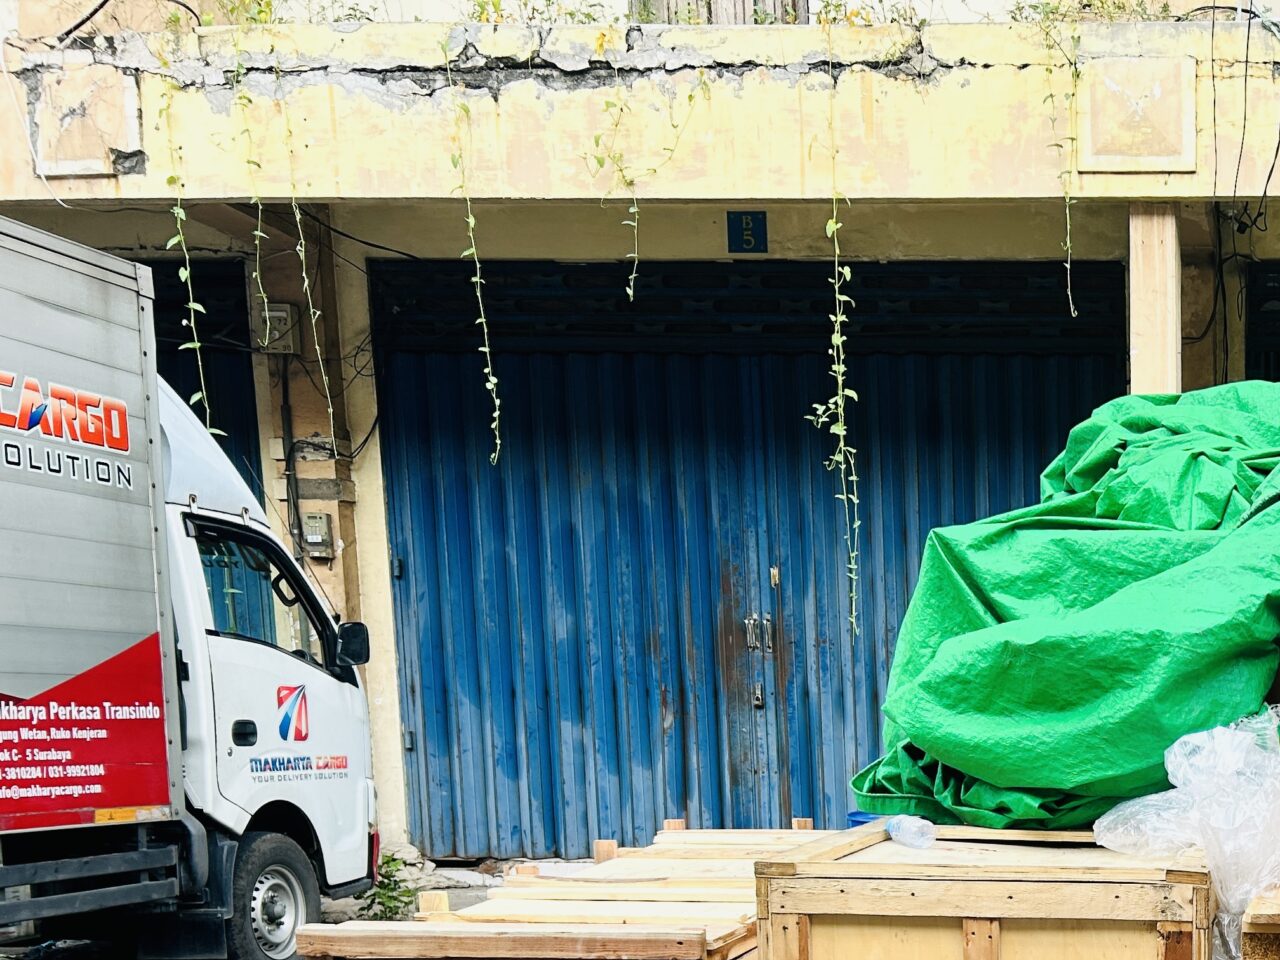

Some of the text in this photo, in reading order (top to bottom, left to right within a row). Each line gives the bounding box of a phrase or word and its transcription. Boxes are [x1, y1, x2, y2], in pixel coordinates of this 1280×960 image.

[742, 215, 753, 229] B
[743, 231, 755, 248] 5
[0, 701, 160, 725] kharya Perkasa Transindo
[20, 728, 50, 741] Wetan,
[50, 727, 71, 740] Ruko
[72, 726, 107, 742] Kenjeran
[33, 747, 72, 763] Surabaya
[249, 756, 313, 773] MAKHARYA
[277, 773, 312, 782] DELIVERY
[314, 771, 349, 780] SOLUTION
